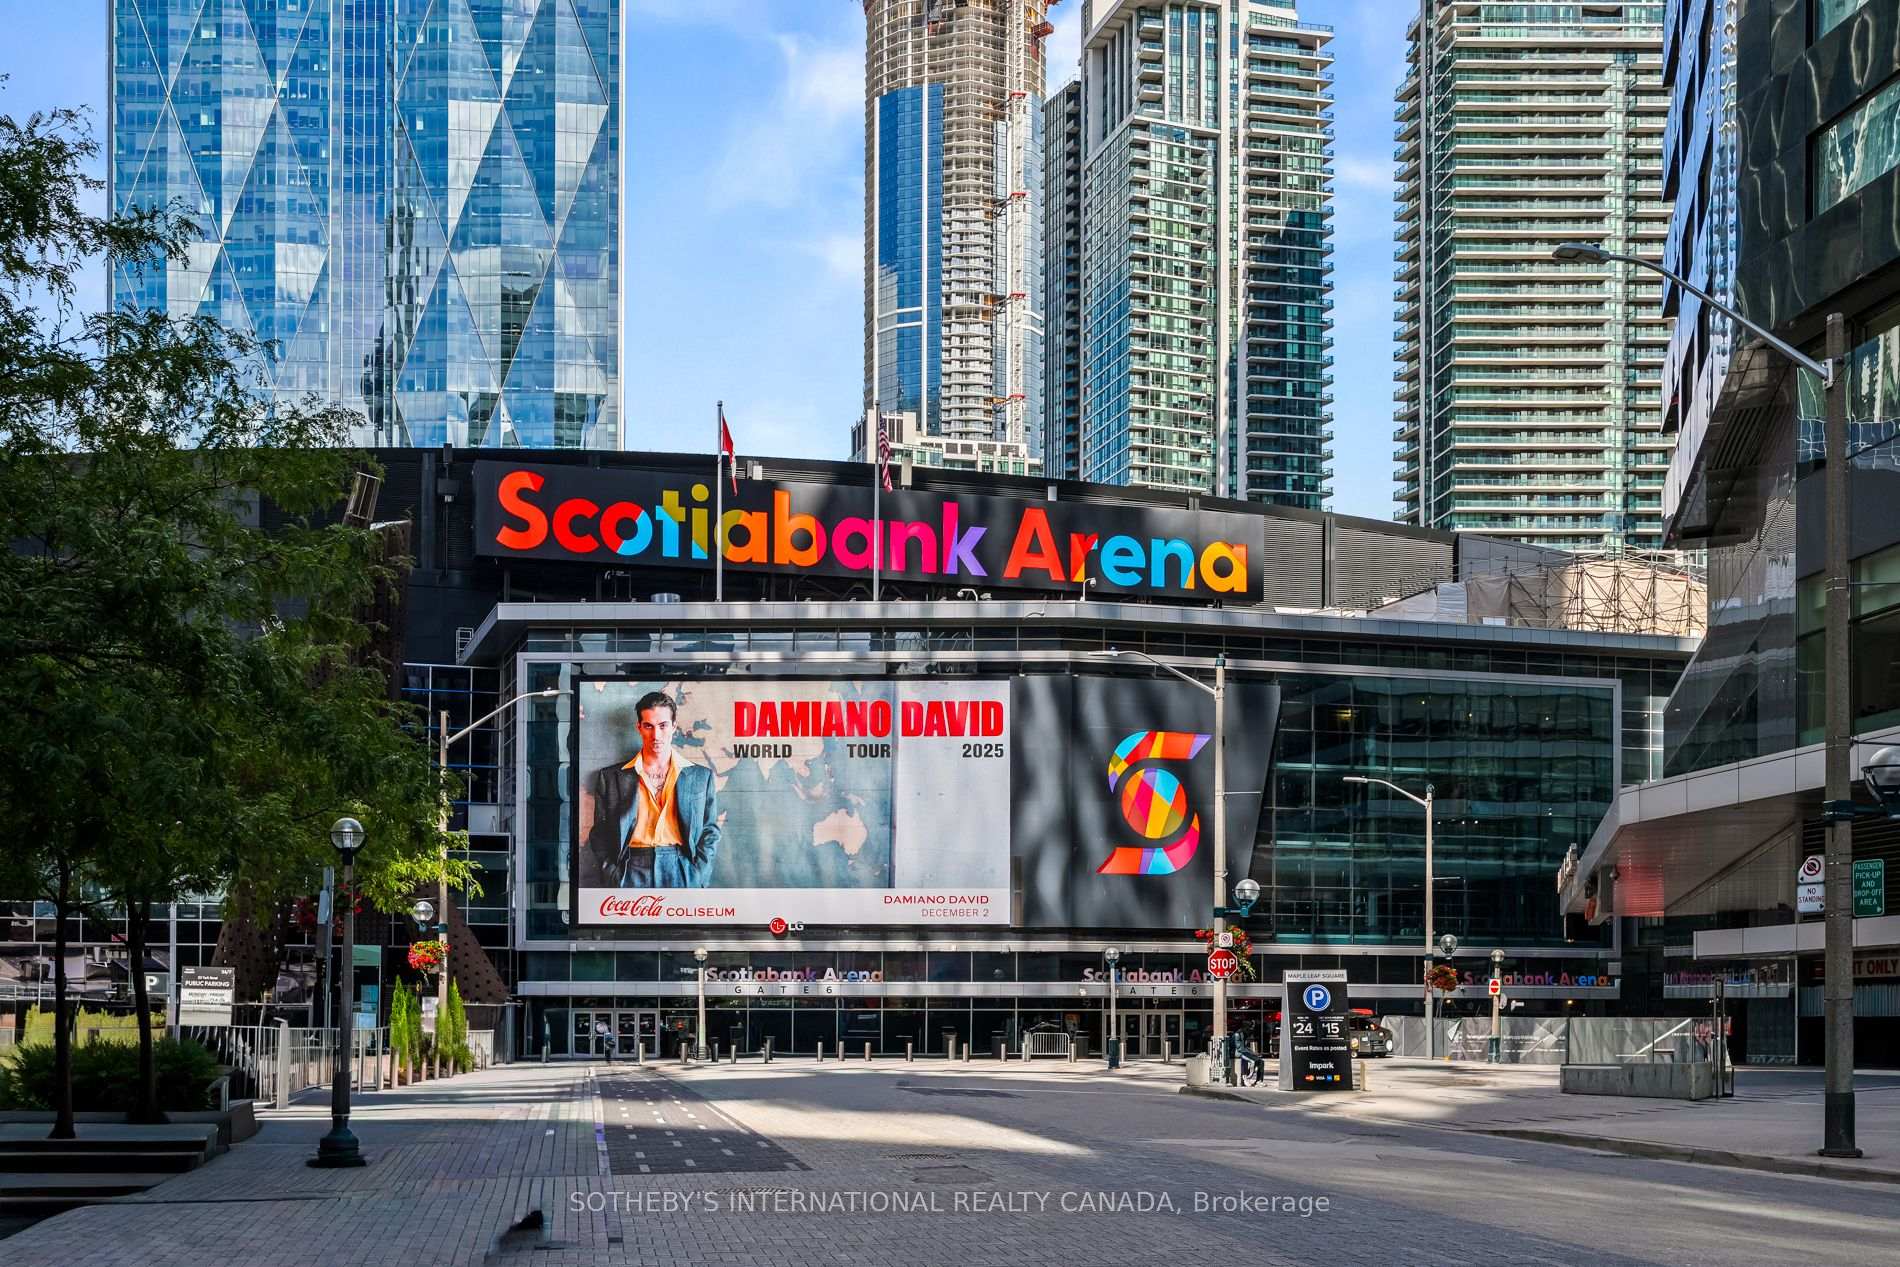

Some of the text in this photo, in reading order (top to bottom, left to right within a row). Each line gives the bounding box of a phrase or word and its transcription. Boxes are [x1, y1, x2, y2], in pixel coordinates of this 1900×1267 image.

[496, 470, 1248, 594] Scotiabank Arena
[734, 700, 1004, 737] DAMIANO DAVID
[734, 743, 1004, 759] WORLD TOUR 2025
[1855, 871, 1881, 880] PICK-UP
[1807, 888, 1816, 896] NO
[884, 895, 989, 904] DAMIANO DAVID
[1859, 898, 1878, 906] AREA
[666, 907, 735, 917] COLISEUM
[921, 908, 989, 917] DECEMBER 2
[788, 921, 804, 931] LG
[1210, 958, 1236, 970] STOP
[1867, 959, 1898, 975] ONLY
[705, 967, 816, 983] Scotiabank
[823, 967, 883, 983] Arena
[1311, 990, 1324, 1006] P
